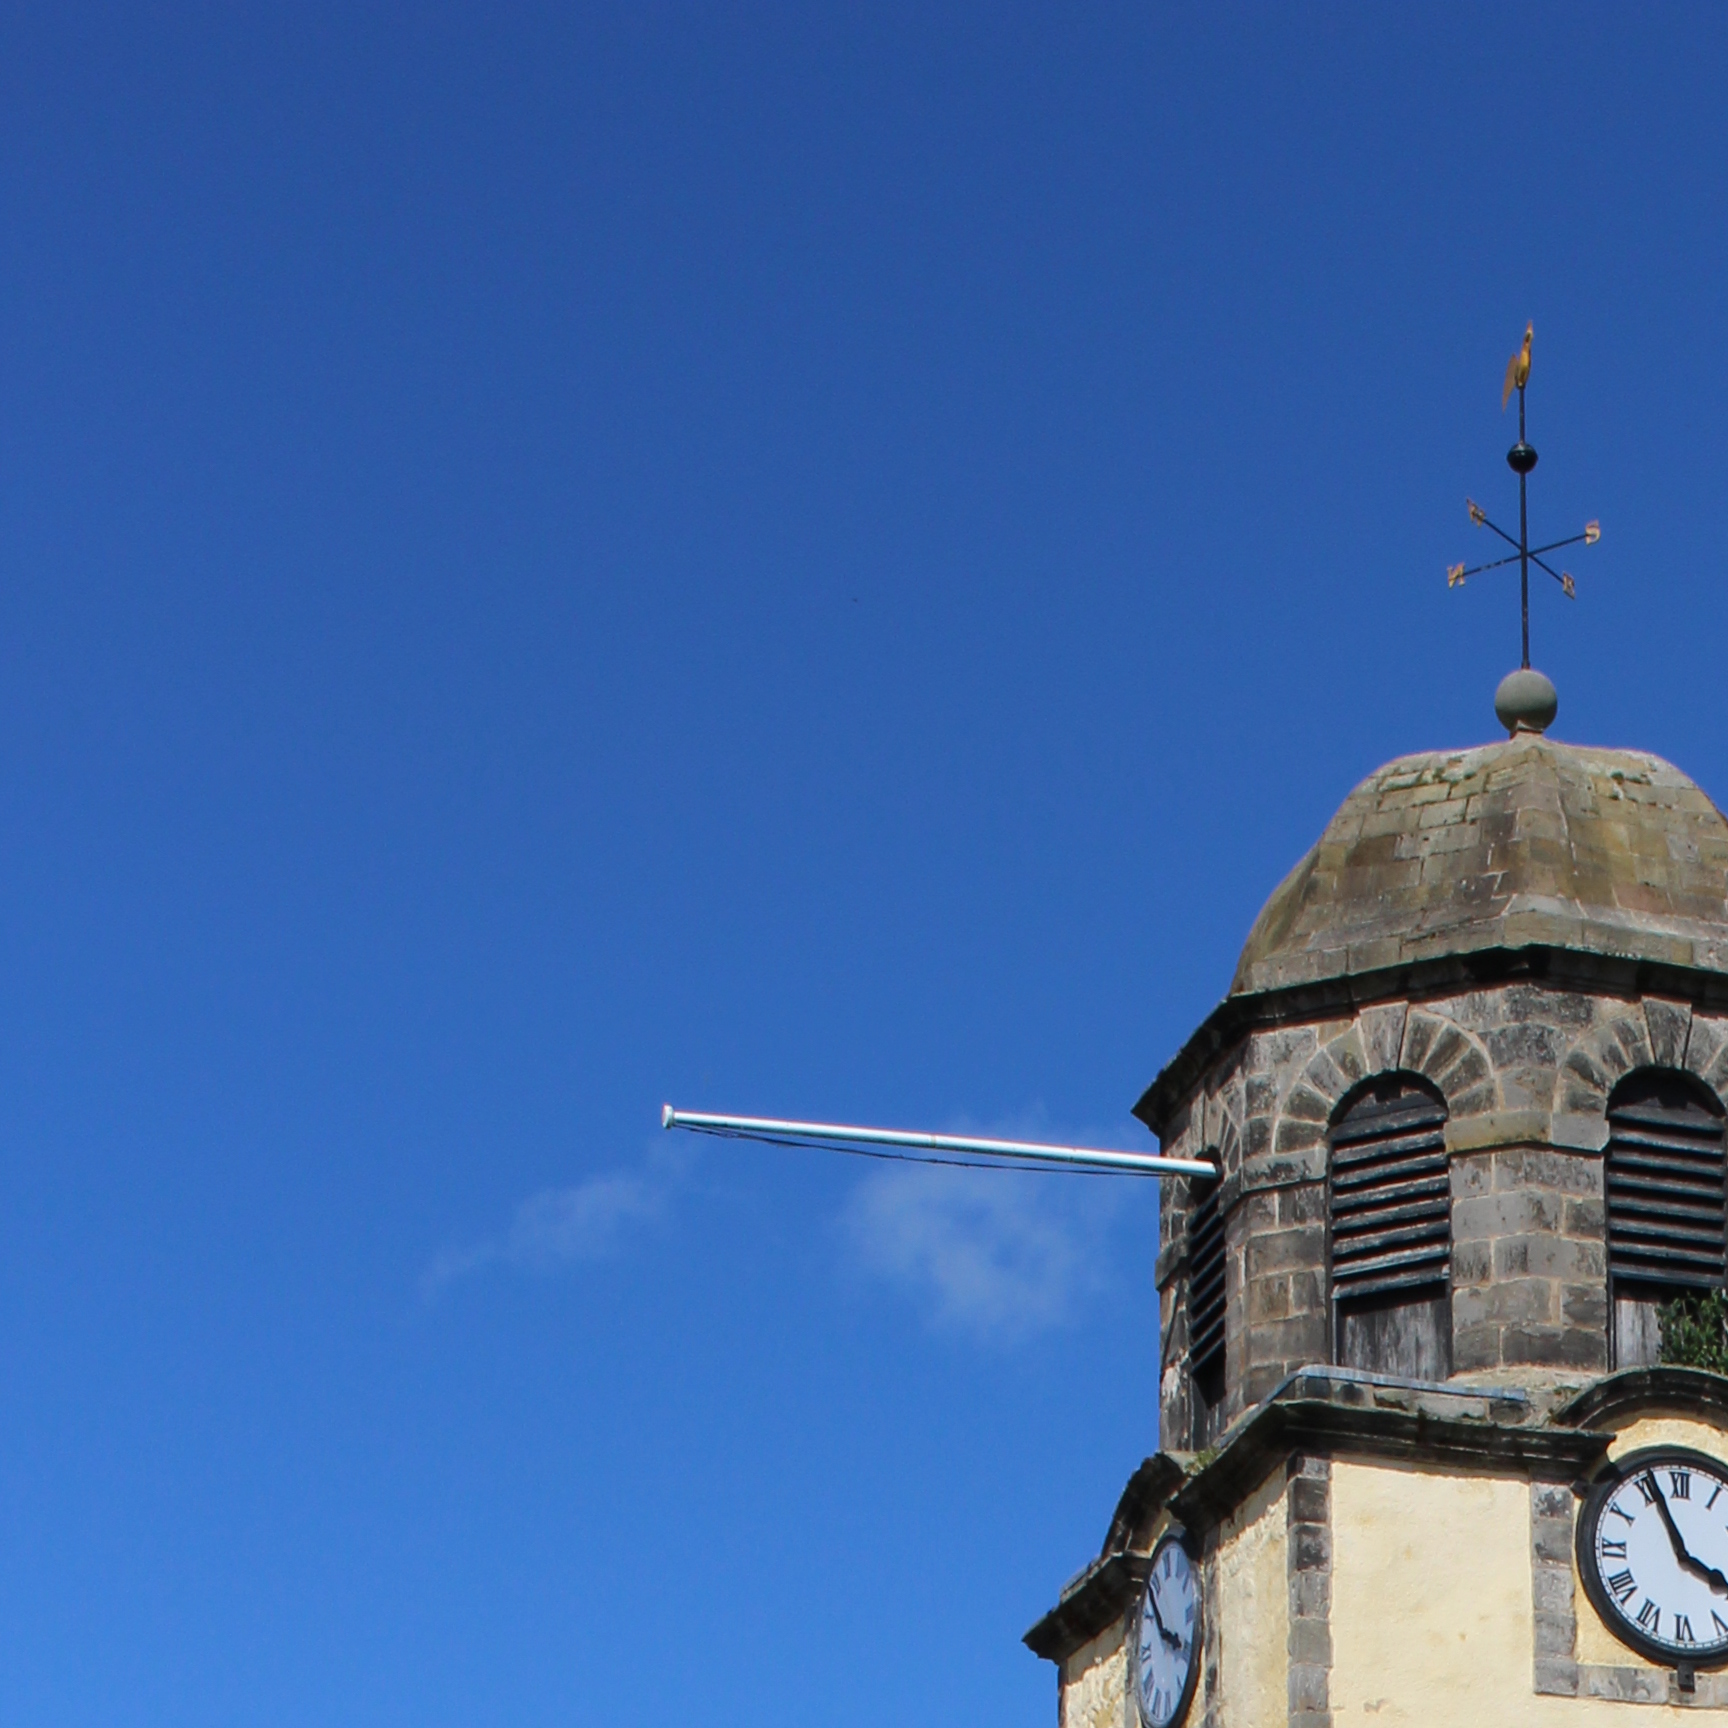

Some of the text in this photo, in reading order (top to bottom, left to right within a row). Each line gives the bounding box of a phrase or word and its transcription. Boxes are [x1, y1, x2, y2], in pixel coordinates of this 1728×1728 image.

[1669, 1471, 1691, 1500] XII
[1705, 1486, 1722, 1510] I
[1608, 1502, 1635, 1527] X
[1601, 1537, 1627, 1560] IX
[1608, 1568, 1638, 1605] VIII
[1636, 1598, 1660, 1634] VII
[1674, 1613, 1695, 1642] VI
